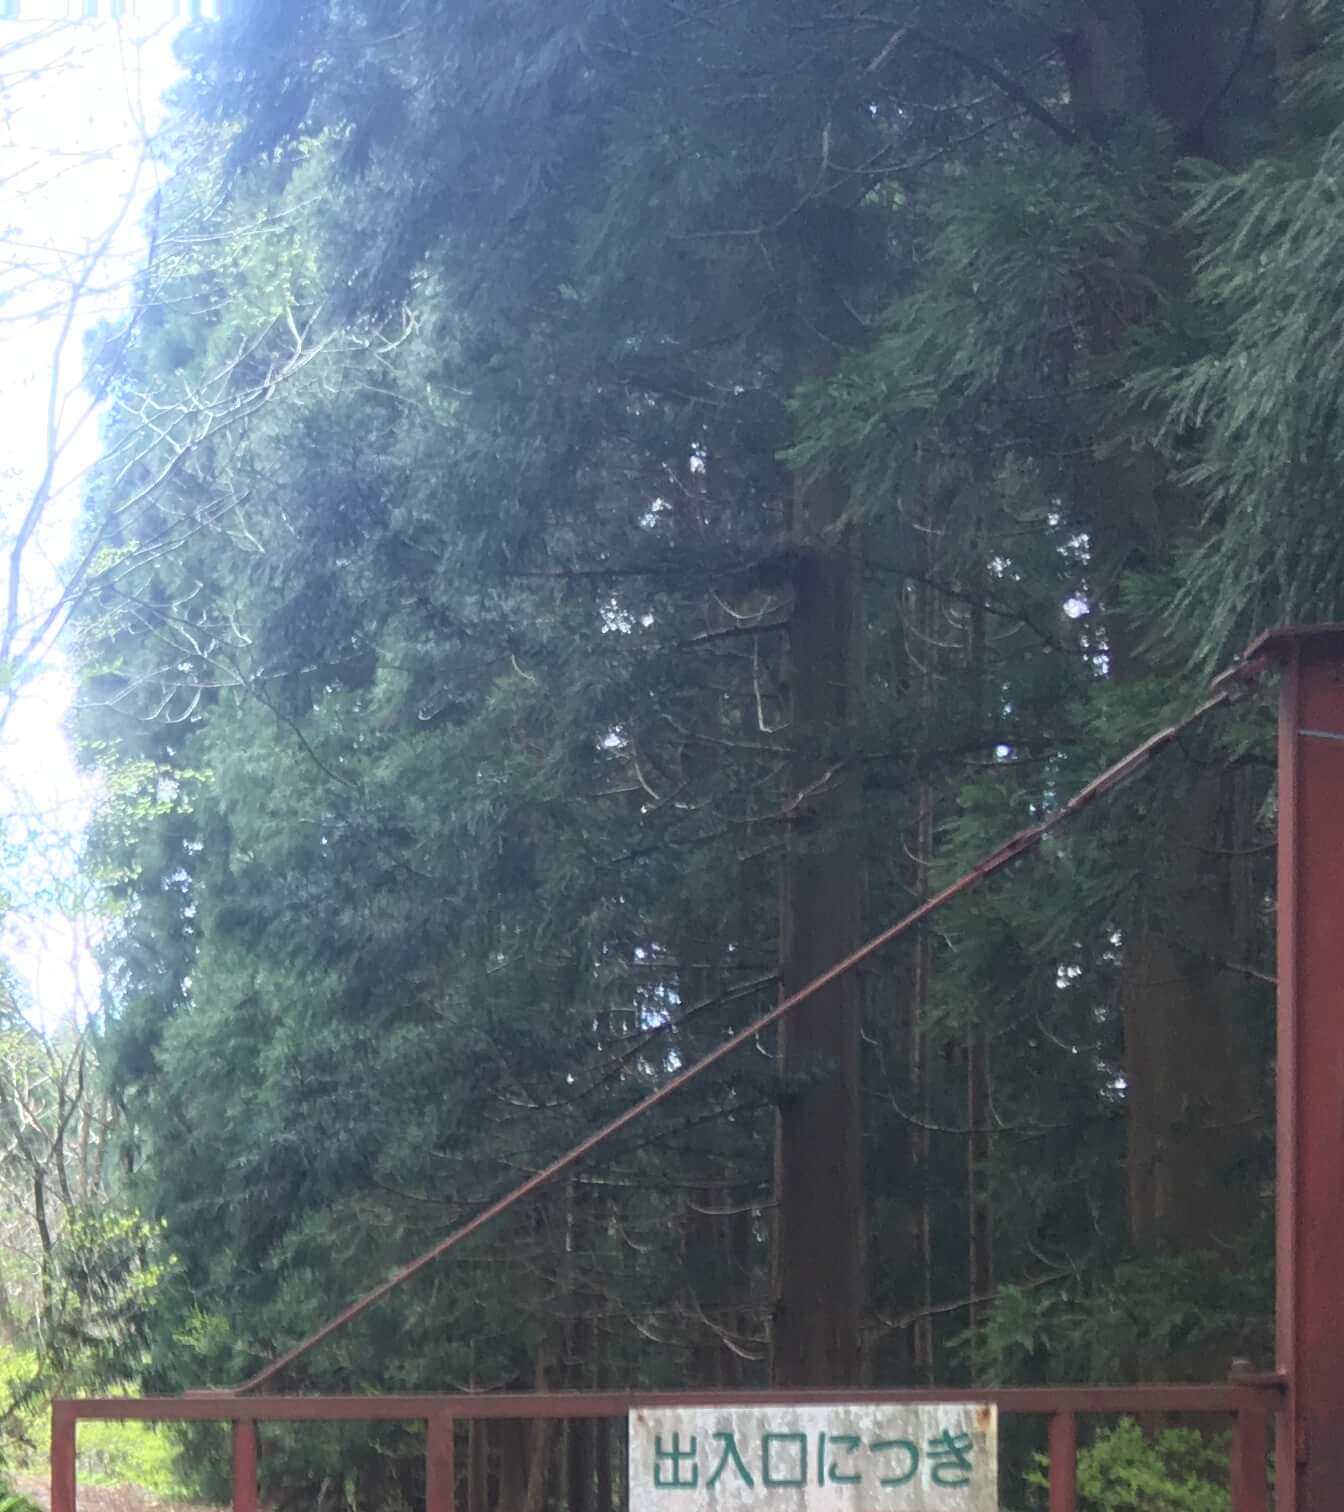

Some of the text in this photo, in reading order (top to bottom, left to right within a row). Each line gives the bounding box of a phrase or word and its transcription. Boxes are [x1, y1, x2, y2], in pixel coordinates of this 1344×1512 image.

[653, 1428, 975, 1490] 出入口につき
